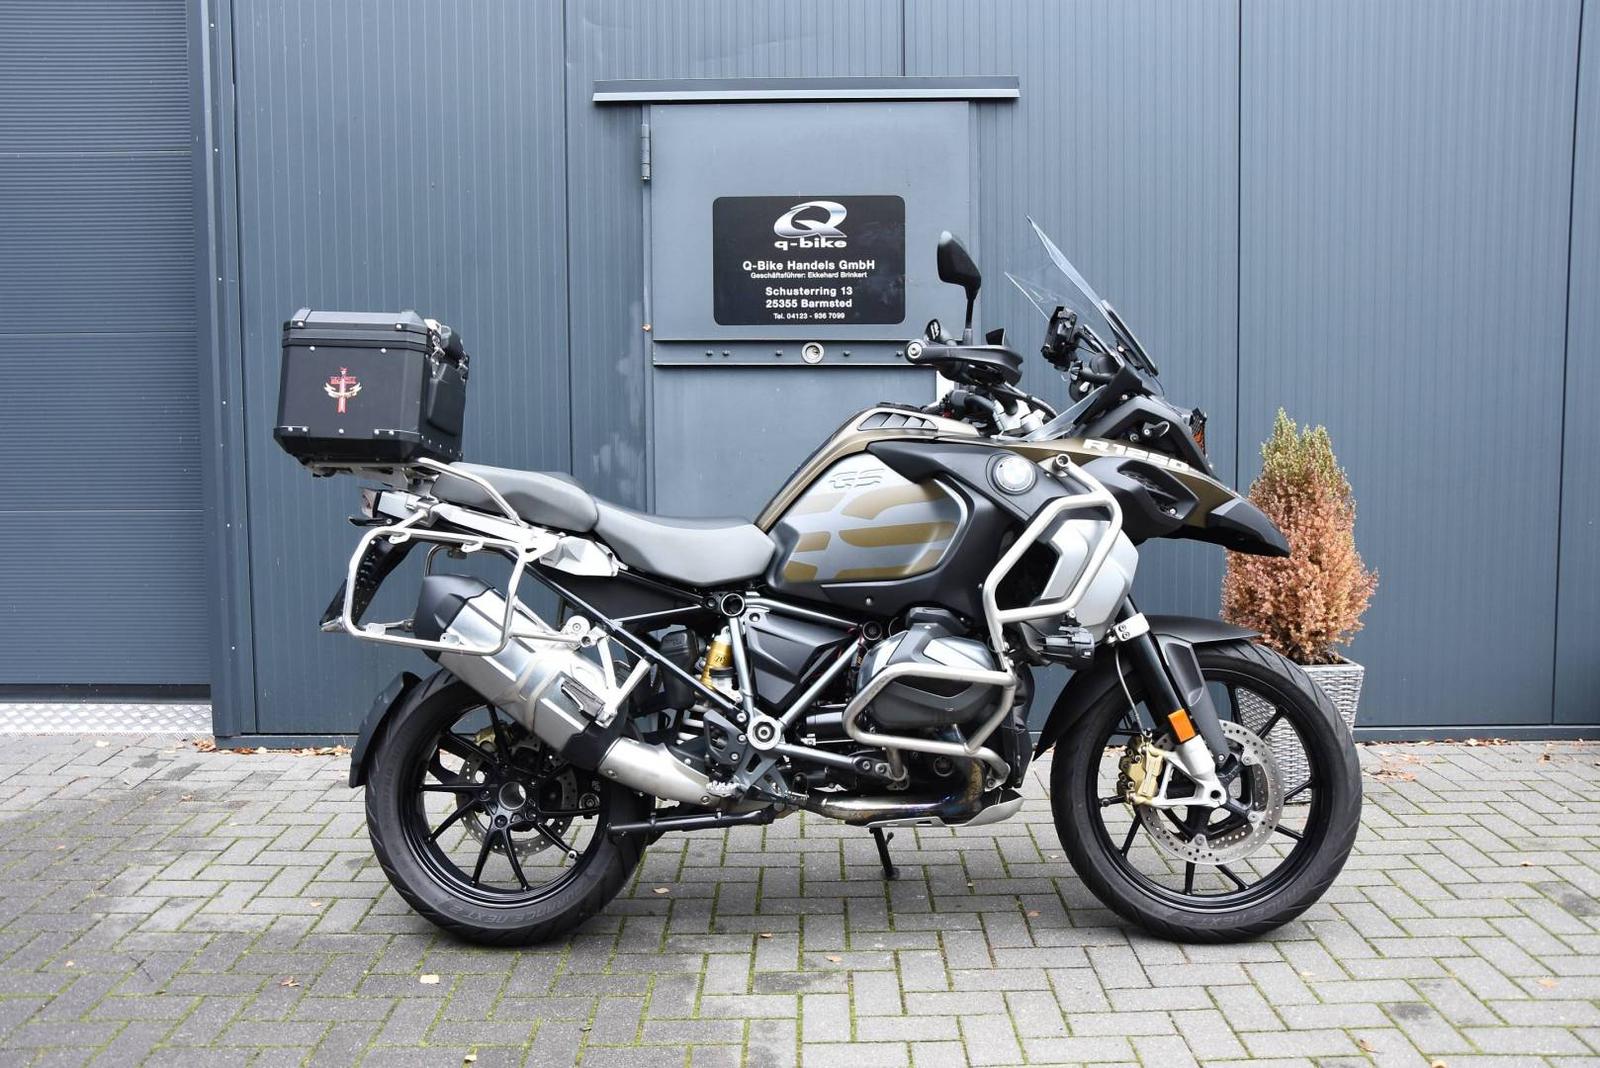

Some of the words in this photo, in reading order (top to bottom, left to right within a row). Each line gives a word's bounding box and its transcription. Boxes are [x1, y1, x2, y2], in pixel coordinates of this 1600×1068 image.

[774, 237, 847, 251] q-bike
[743, 260, 783, 271] Q-Bike
[787, 260, 835, 270] Handels
[839, 259, 875, 270] GmbH
[750, 271, 806, 279] Geschäftsführer:
[765, 286, 837, 297] Schusterring
[841, 286, 853, 296] 13
[765, 299, 798, 308] 25355
[828, 468, 885, 489] GS
